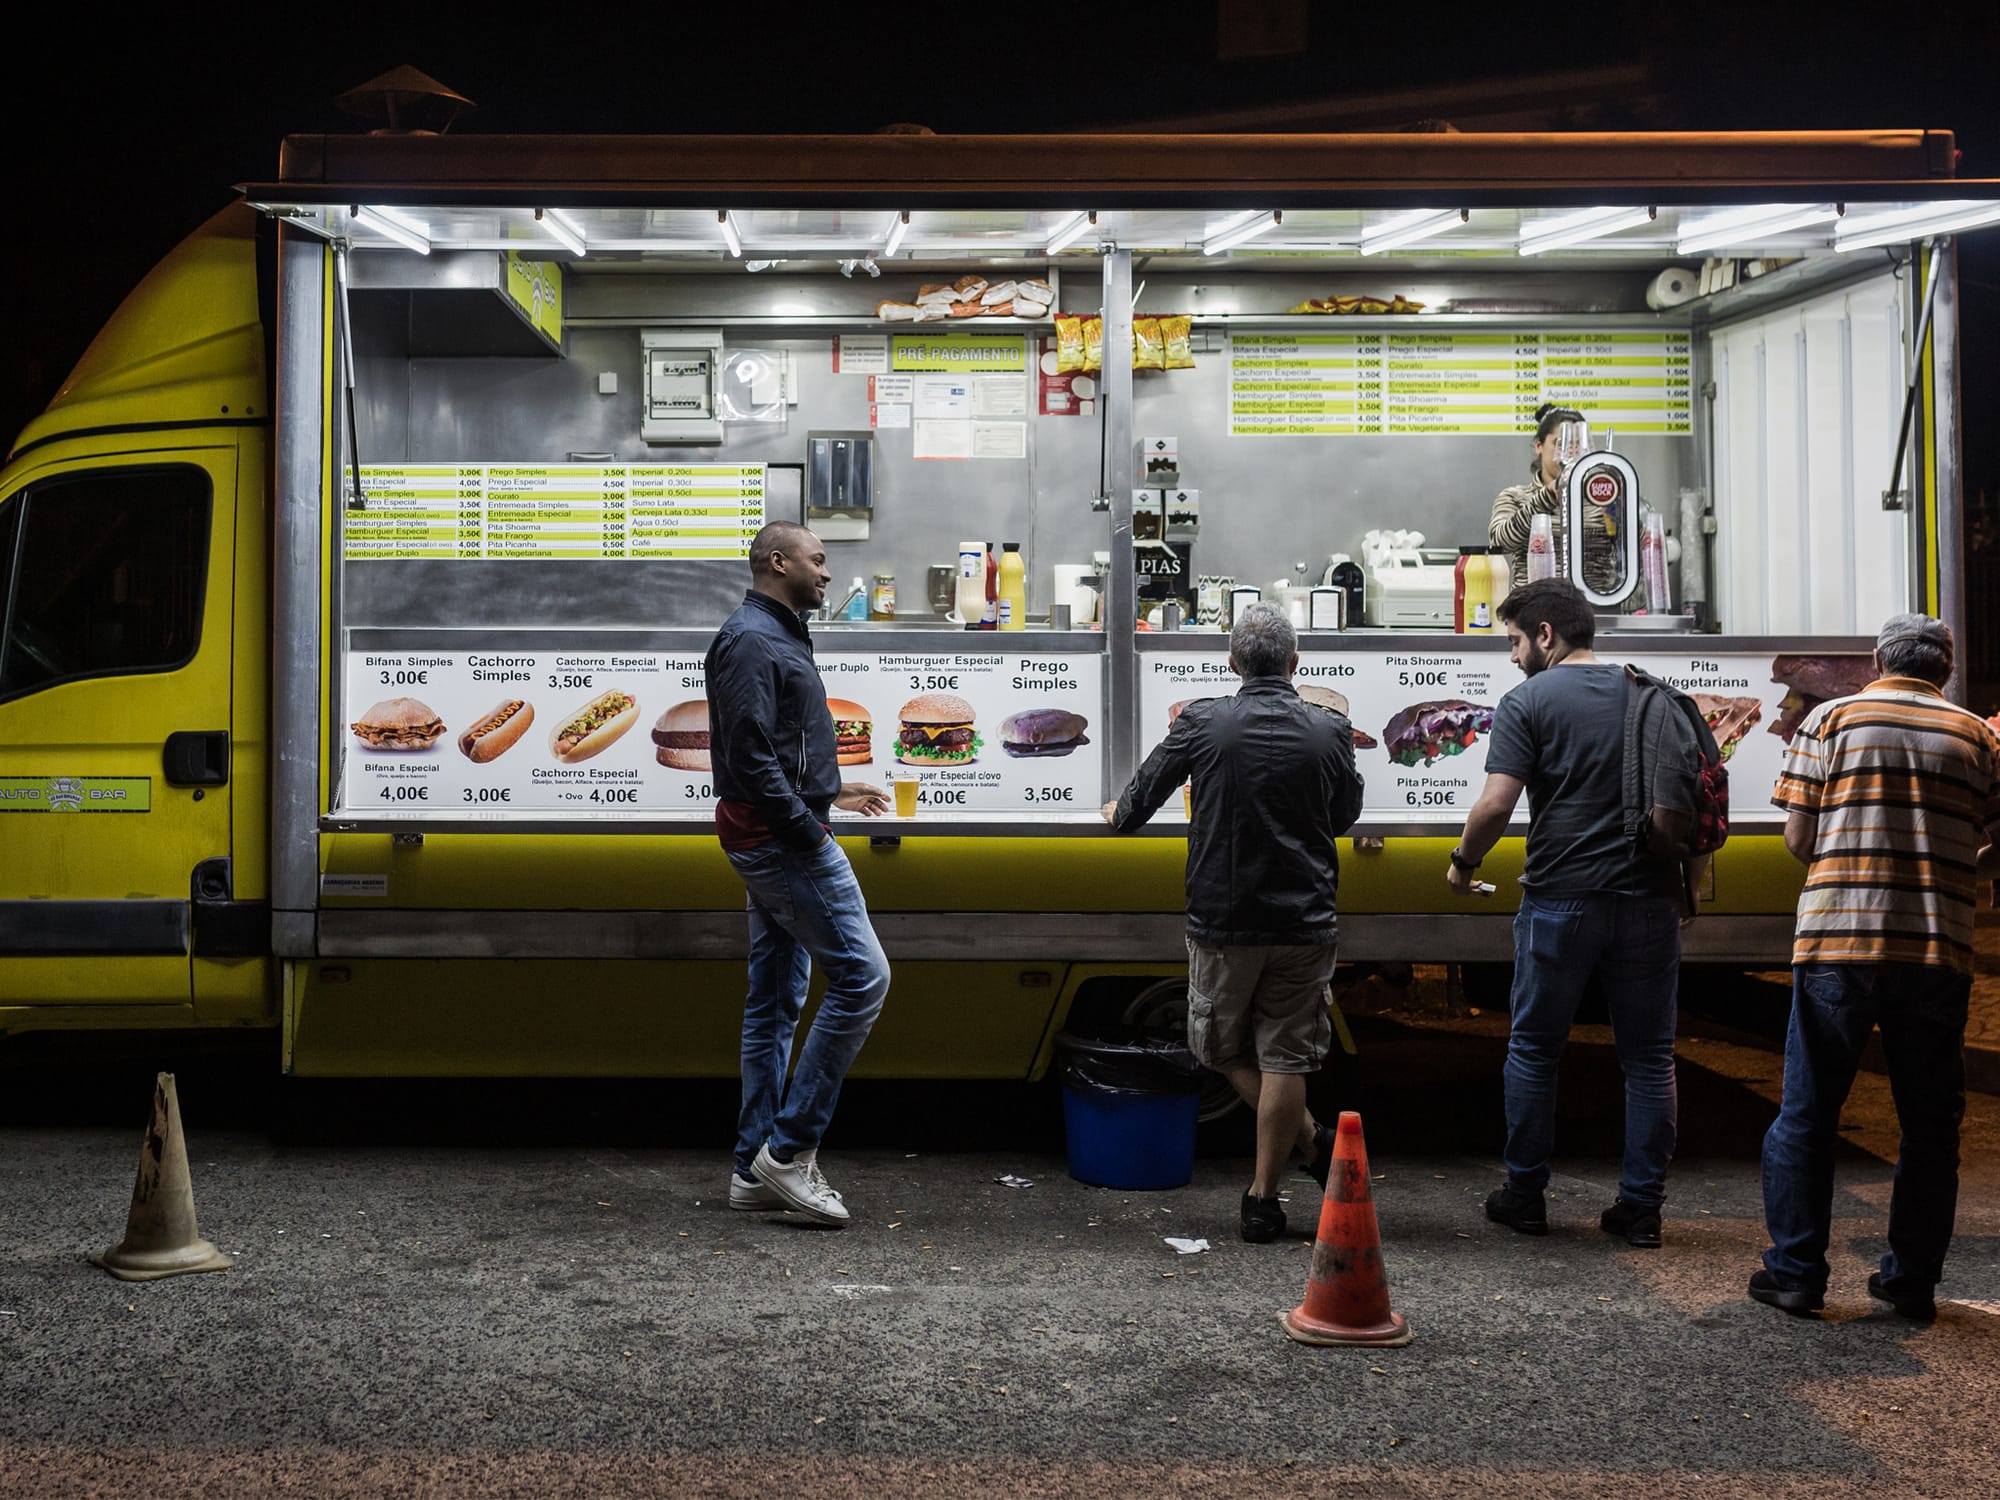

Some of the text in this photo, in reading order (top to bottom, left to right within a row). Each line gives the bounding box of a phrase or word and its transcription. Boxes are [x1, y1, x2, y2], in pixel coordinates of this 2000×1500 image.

[897, 344, 1020, 361] PRÉ-PAGAMENTO
[490, 468, 547, 477] Prego Simples
[603, 469, 626, 477] 3,50€
[632, 468, 692, 477] Imperial 0,20cl
[741, 468, 762, 477] 1,00€
[488, 478, 547, 486] Prego Especial
[603, 480, 625, 488] 4,50€
[632, 479, 692, 487] Imperial 0,30cl
[741, 479, 762, 487] 1,50€
[603, 492, 625, 500] 3,00€
[632, 489, 692, 497] Imperial 0,50cl
[741, 489, 762, 497] 3,00€
[538, 501, 569, 509] Simples
[603, 501, 625, 509] 3,50€
[741, 499, 762, 507] 1,50€
[538, 510, 571, 518] Especial
[632, 509, 662, 517] Cerveja
[684, 509, 708, 517] 0,33cl
[741, 509, 762, 517] 2,00€
[505, 523, 541, 531] Shoarma
[603, 523, 625, 532] 5,00€
[632, 518, 678, 527] Água 0,50cl
[741, 519, 762, 527] 1,00€
[505, 532, 533, 540] Frango
[603, 532, 625, 540] 5,50€
[603, 541, 625, 549] 6,50€
[505, 549, 552, 557] Vegetariana
[603, 550, 625, 558] 4,00€
[1140, 559, 1181, 574] PIAS
[366, 657, 453, 668] Bifana Simples
[468, 655, 536, 667] Cachorro
[556, 657, 605, 666] Cachorro
[611, 657, 656, 667] Especial
[879, 656, 1004, 667] Hamburguer Especial
[1386, 656, 1462, 666] Pita Shoarma
[1690, 660, 1719, 672] Pita
[840, 663, 870, 674] Duplo
[1020, 659, 1069, 675] Prego
[1154, 662, 1195, 675] Prego
[1295, 664, 1355, 677] ourato
[380, 670, 428, 687] 3,00€
[472, 670, 531, 683] Simples
[1399, 672, 1448, 688] 5,00€
[548, 675, 593, 690] 3,50€
[910, 675, 959, 692] 3,50€
[1012, 676, 1078, 692] Simples
[1662, 676, 1749, 690] Vegetariana
[1466, 688, 1488, 696] 0,50€
[365, 763, 440, 773] Bifana Especial
[531, 768, 638, 780] Cachorro Especial
[940, 771, 976, 782] Especial
[978, 771, 1001, 780] c/ovo
[1397, 778, 1468, 787] Pita Picanha
[90, 789, 126, 799] BAR
[380, 786, 428, 803] 4,00€
[463, 788, 511, 804] 3,00€
[565, 792, 583, 800] Ovo
[589, 788, 638, 805] 4,00€
[685, 785, 711, 800] 3,0
[1024, 787, 1074, 804] 3,50€
[917, 790, 967, 807] 4,00€
[1406, 791, 1456, 807] 6,50€
